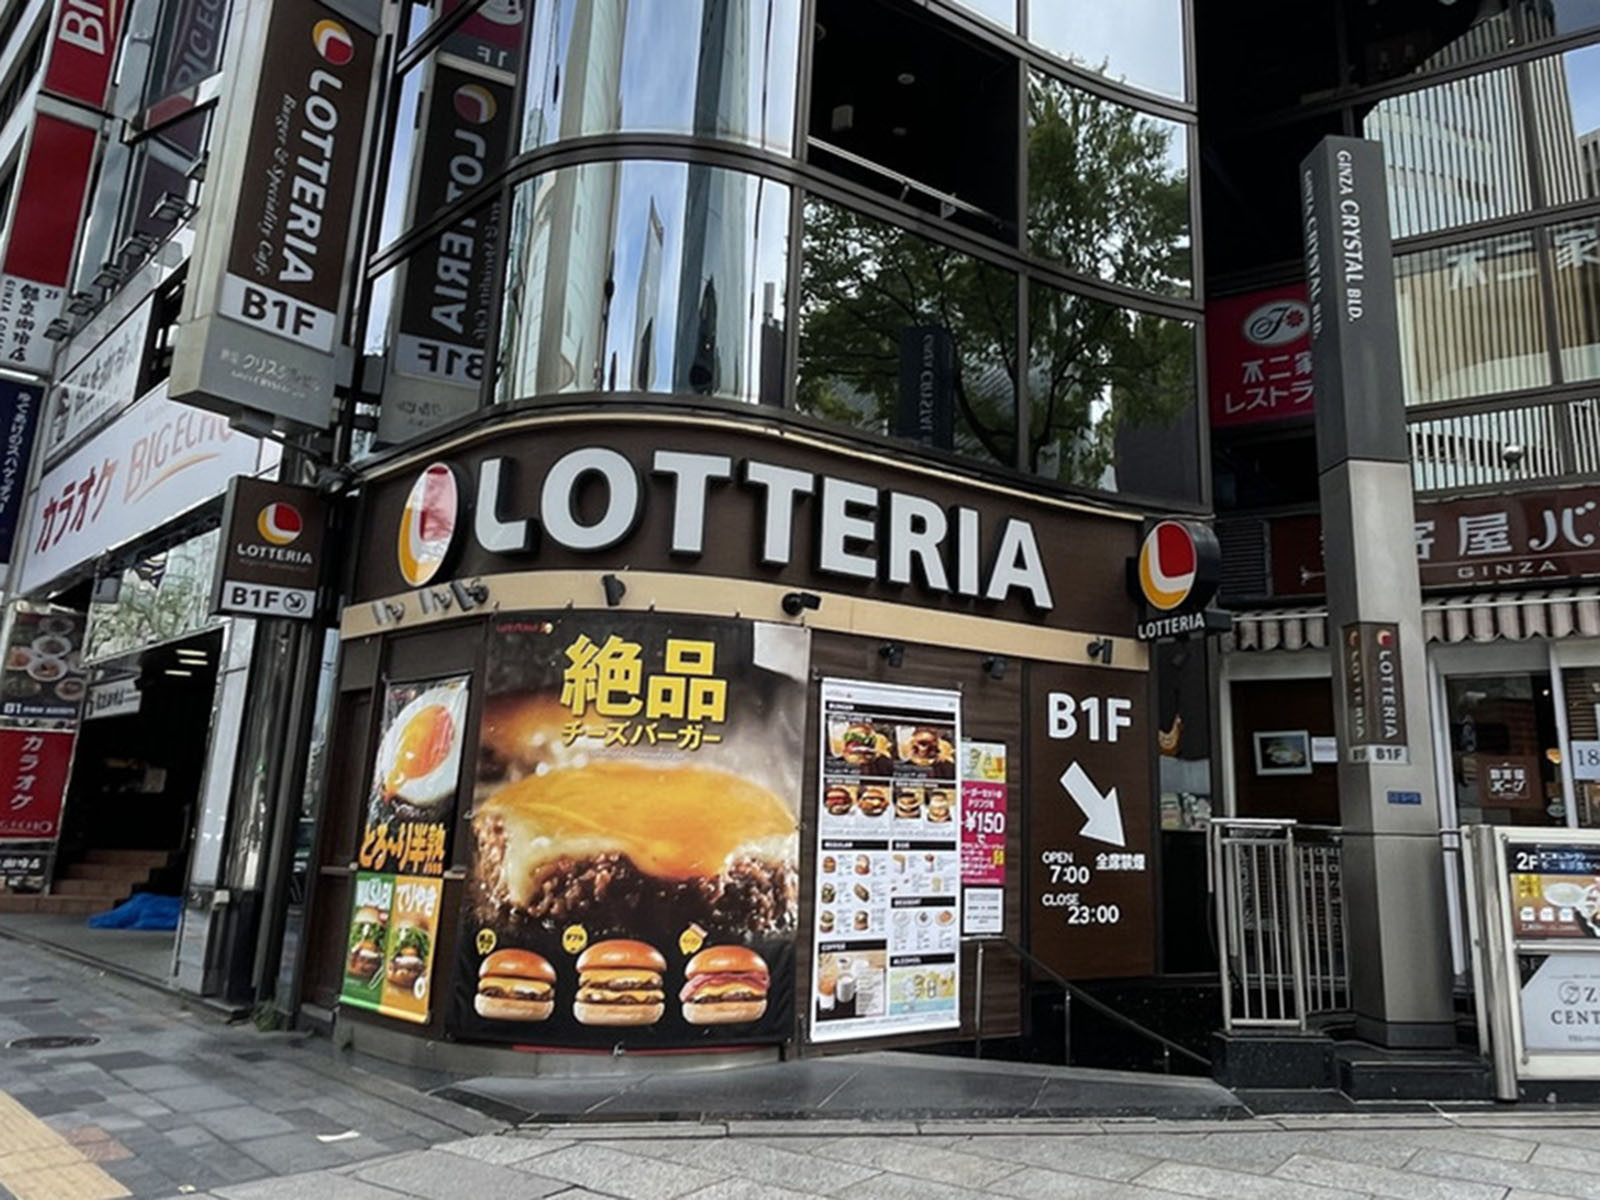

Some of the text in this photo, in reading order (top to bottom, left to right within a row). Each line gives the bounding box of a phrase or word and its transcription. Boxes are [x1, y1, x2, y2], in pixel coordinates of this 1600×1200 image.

[279, 69, 343, 282] LOTTERIA
[1337, 150, 1355, 195] GINZA
[1340, 199, 1365, 283] CRYSTAL
[241, 286, 317, 336] B1F
[1225, 379, 1314, 414] レストラ
[34, 458, 119, 554] カラオケ
[475, 448, 1054, 611] LOTTERIA
[237, 543, 313, 565] LOTTERIA
[1457, 560, 1558, 579] GINZA
[231, 586, 280, 609] B1F
[1137, 612, 1206, 639] LOTTERIA
[560, 633, 728, 722] 絶品
[1379, 650, 1399, 739] LOTTERIA
[1048, 692, 1133, 743] B1F
[562, 720, 722, 751] チーズバーガー
[10, 735, 44, 810] カラオケ
[1042, 851, 1074, 864] OPEN
[1050, 865, 1090, 884] 7:00
[1516, 852, 1538, 870] 2F
[1042, 892, 1080, 907] CLOSE
[1067, 904, 1120, 924] 23:00
